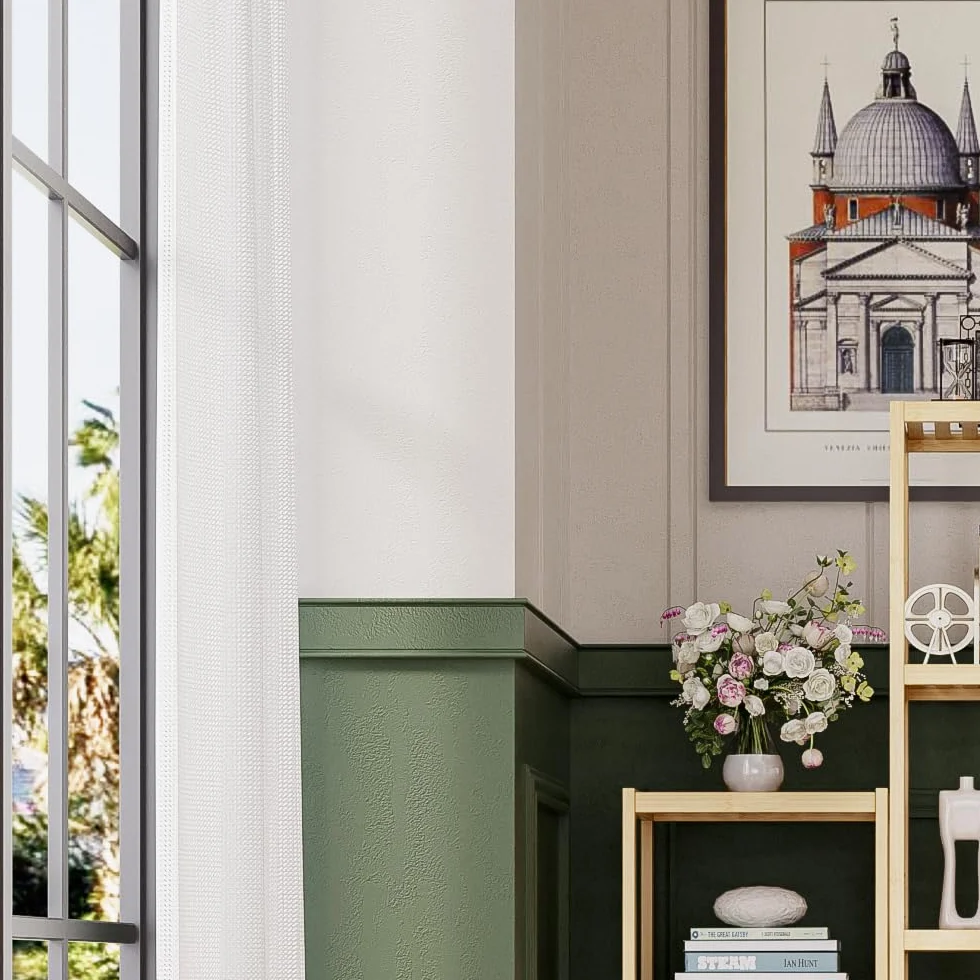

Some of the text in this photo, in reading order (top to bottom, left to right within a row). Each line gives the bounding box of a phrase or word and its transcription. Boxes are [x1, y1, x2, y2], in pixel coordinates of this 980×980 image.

[697, 955, 757, 970] STEAM
[783, 958, 819, 968] IAN HUNT
